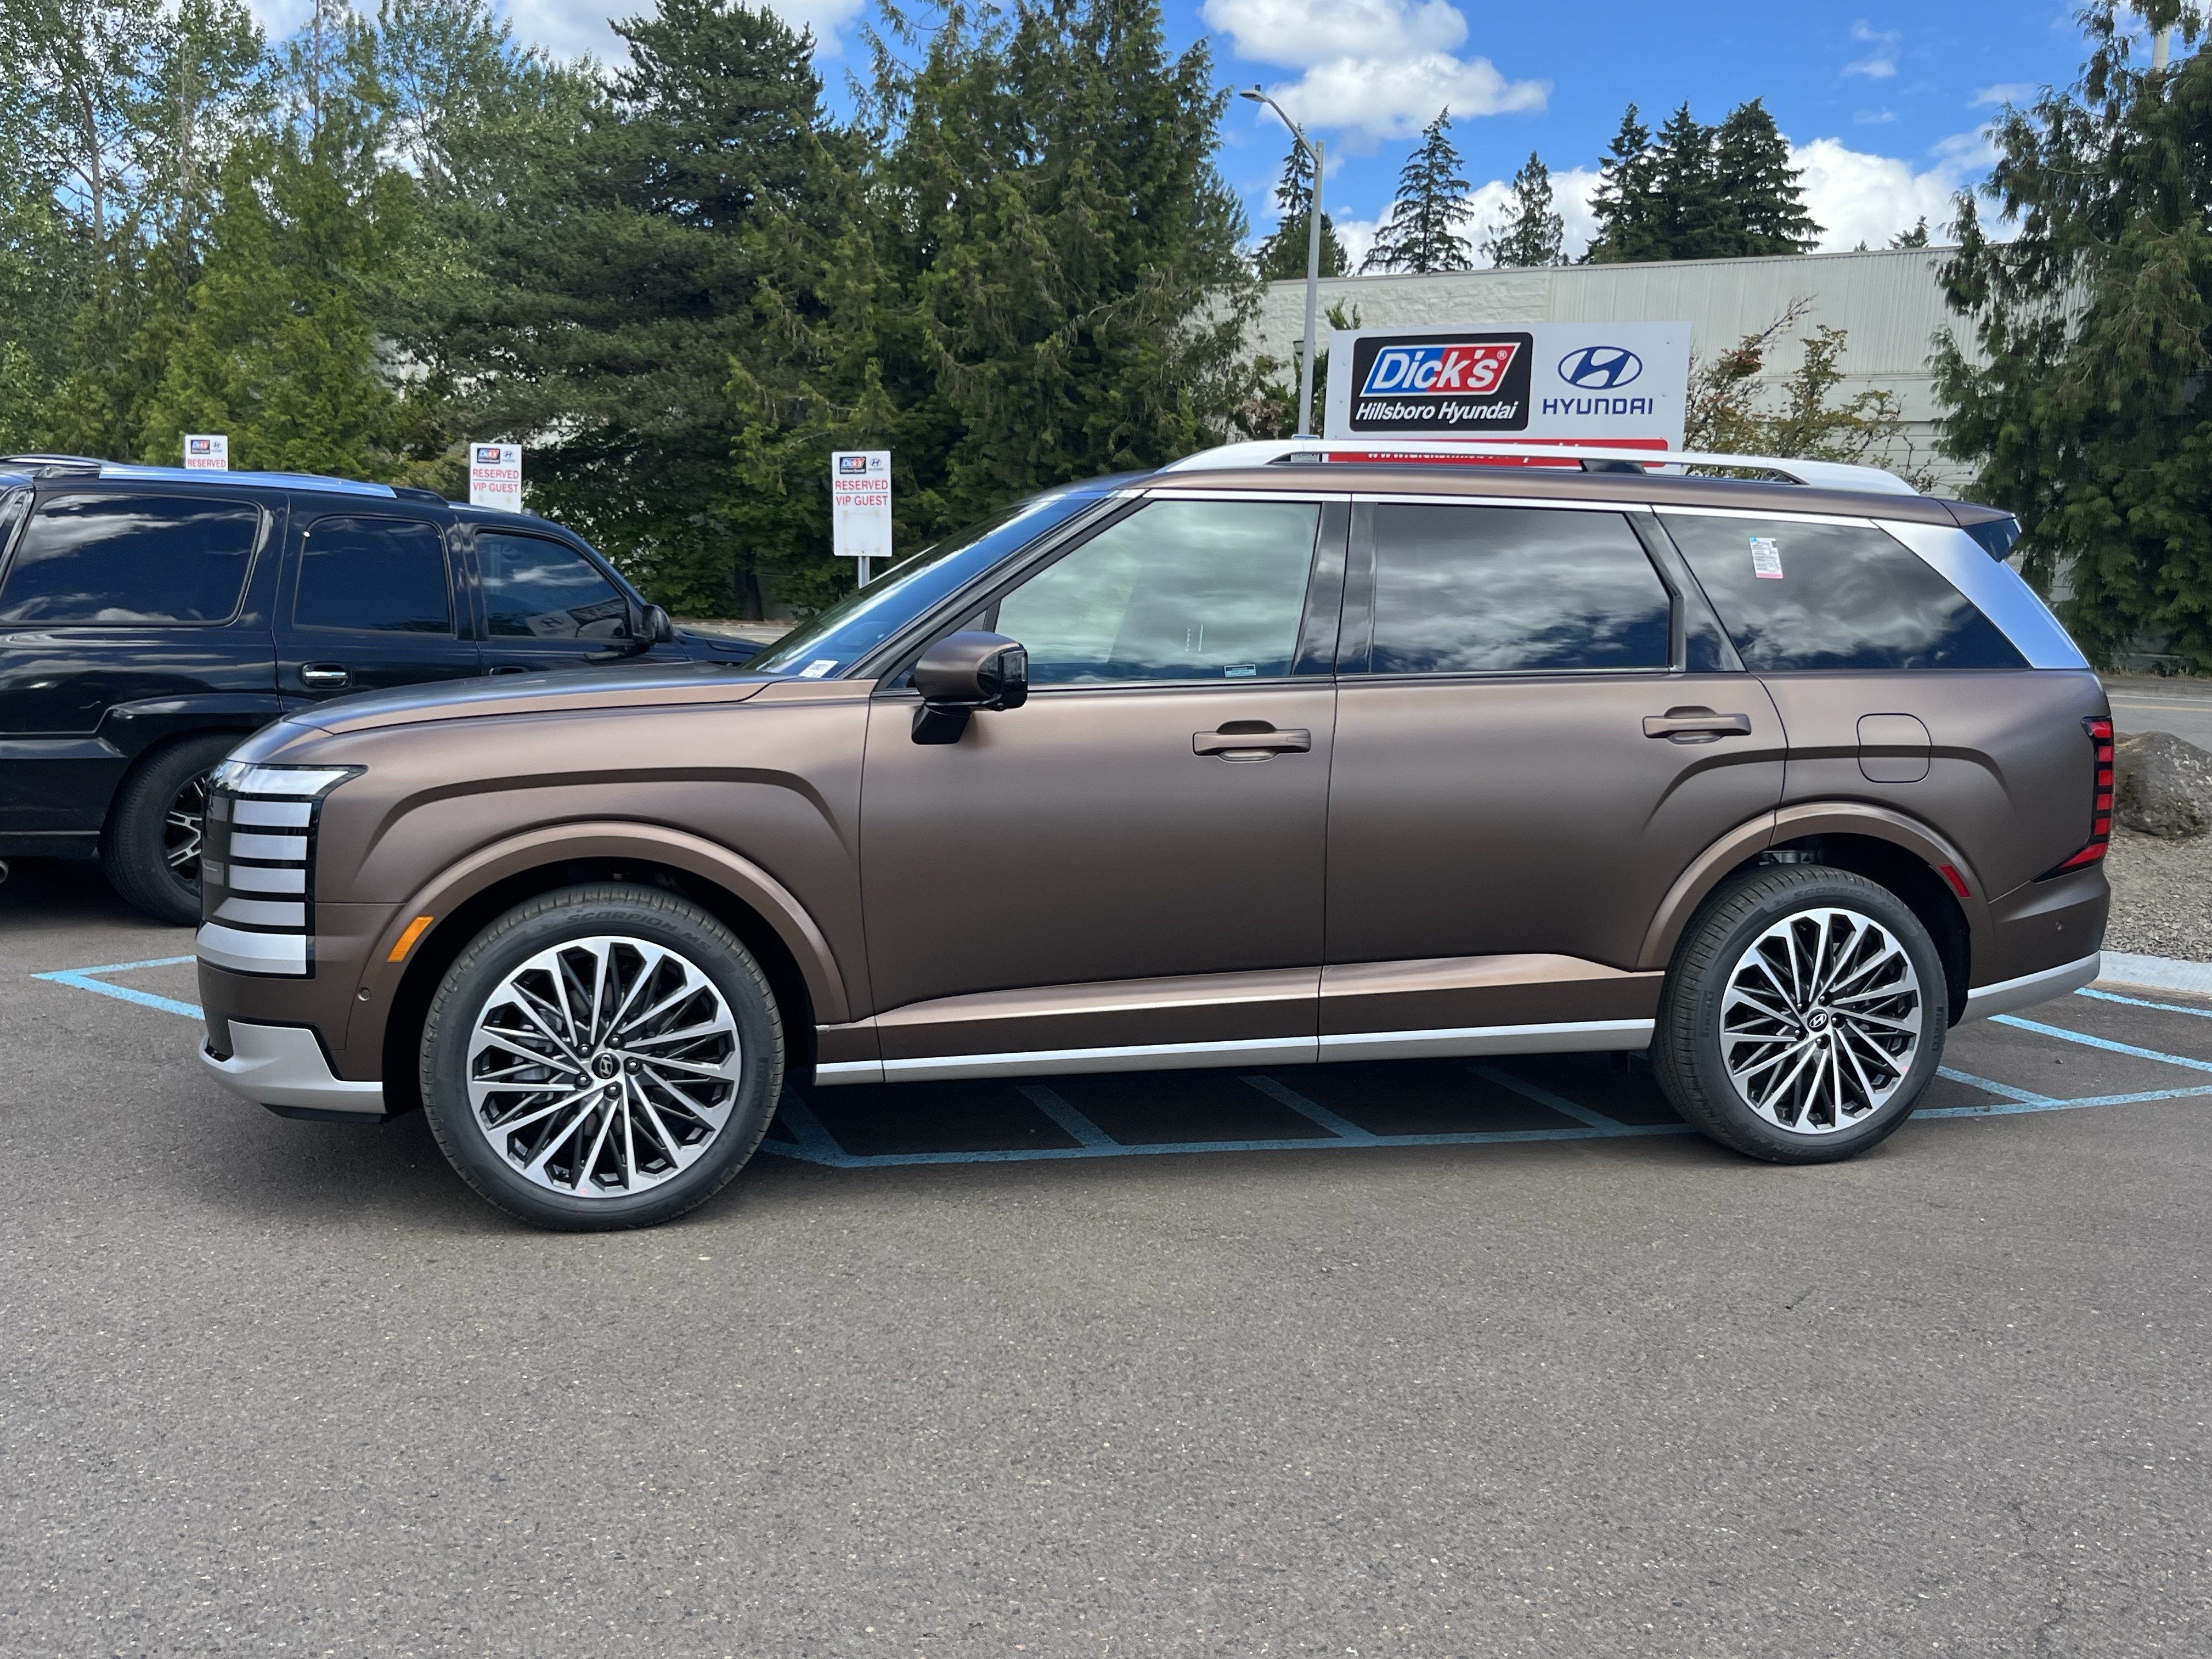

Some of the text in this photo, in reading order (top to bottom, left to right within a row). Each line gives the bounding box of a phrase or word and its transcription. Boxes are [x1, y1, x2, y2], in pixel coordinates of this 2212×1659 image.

[1372, 349, 1498, 389] Dick's
[1542, 398, 1653, 415] HYUNDAI
[1355, 401, 1519, 424] Hillsboro Hyundai
[187, 459, 226, 467] RESERVED
[472, 469, 519, 479] RESERVED
[473, 483, 518, 493] VIP GUEST
[835, 480, 888, 490] RESERVED
[836, 496, 888, 505] VIP GUEST
[567, 911, 678, 932] SCORPION
